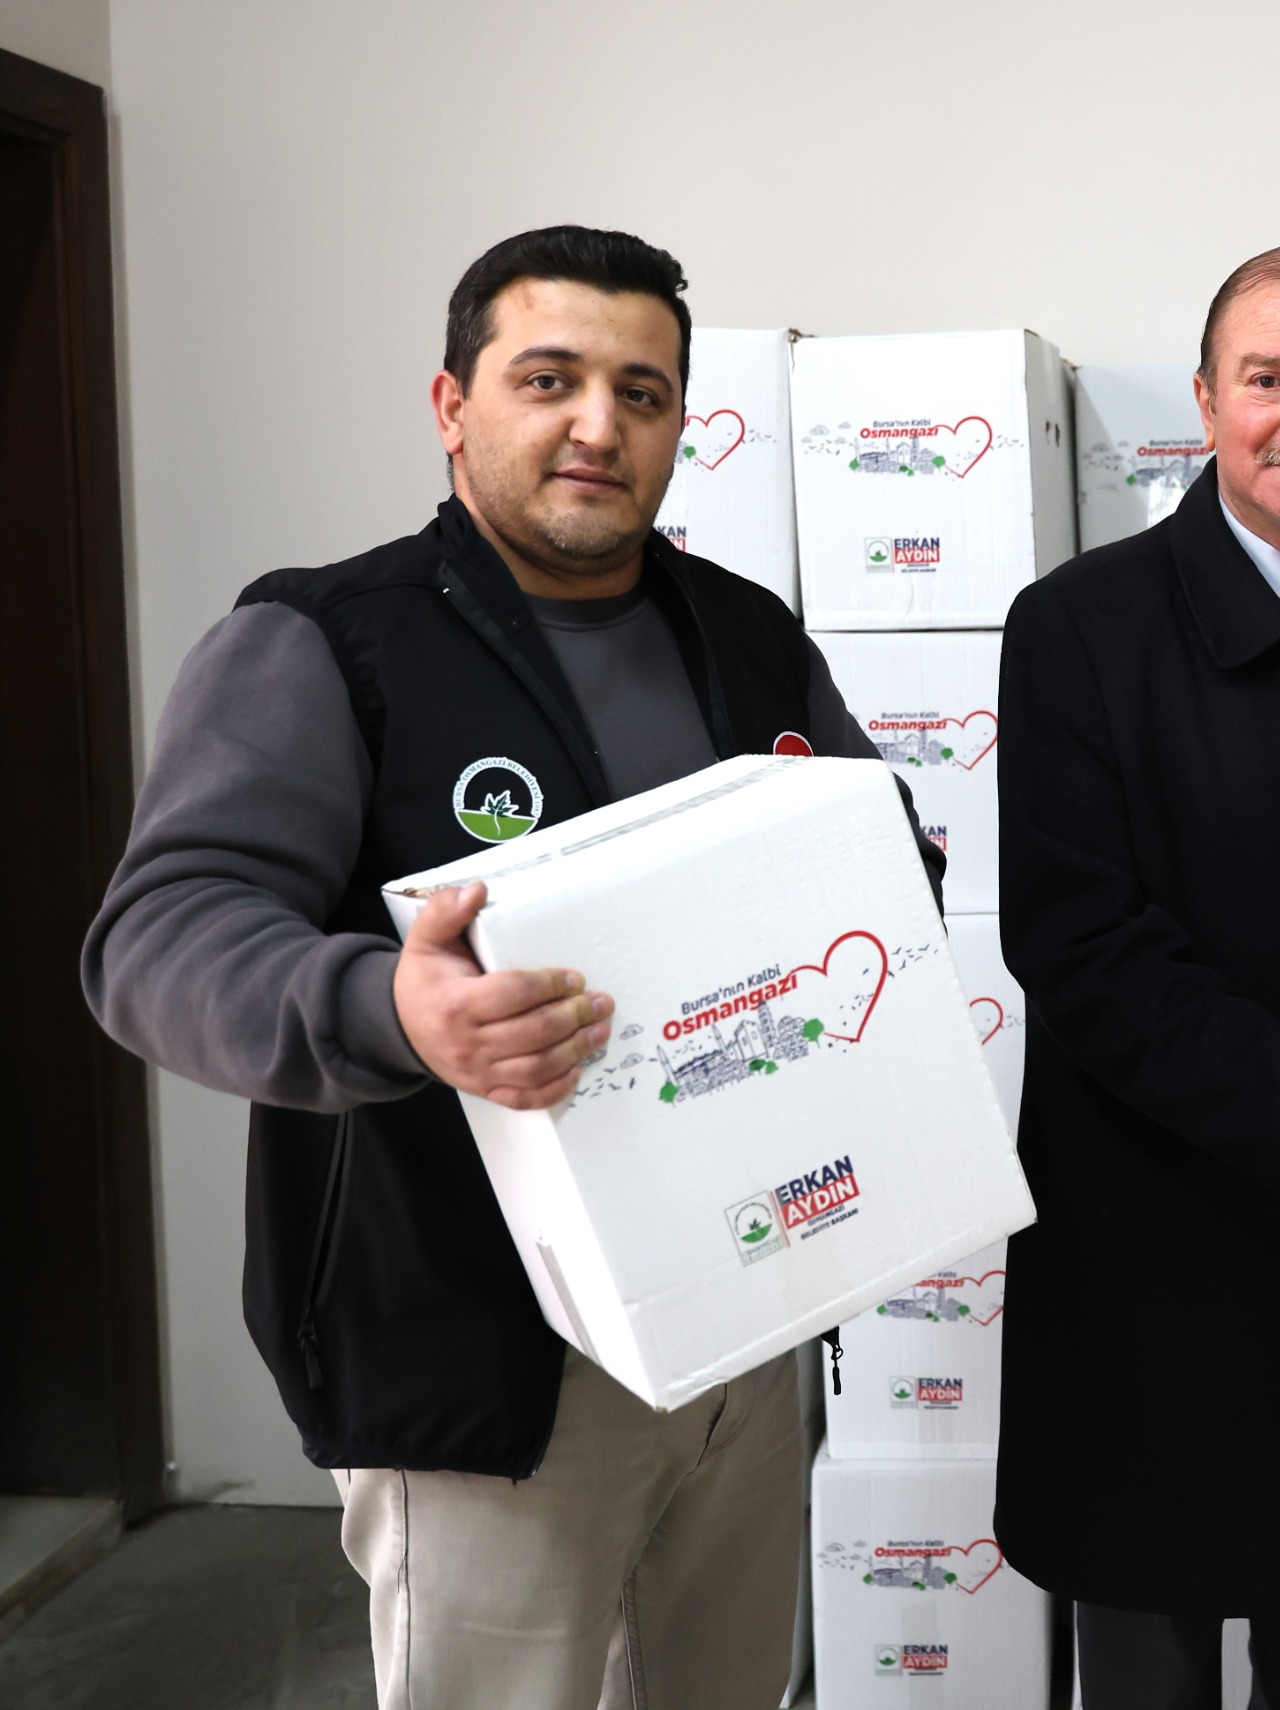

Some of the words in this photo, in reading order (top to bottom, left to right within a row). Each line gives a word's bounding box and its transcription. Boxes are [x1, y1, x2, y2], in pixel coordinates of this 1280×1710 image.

[657, 525, 687, 538] KAN
[895, 537, 940, 549] ERKAN
[896, 549, 938, 562] AYDIN
[662, 974, 798, 1041] Osmangazi
[681, 983, 745, 1015] Bursa'nın
[747, 963, 782, 988] Kalbi
[775, 1155, 854, 1206] ERKAN
[787, 1177, 856, 1226] AYDIN
